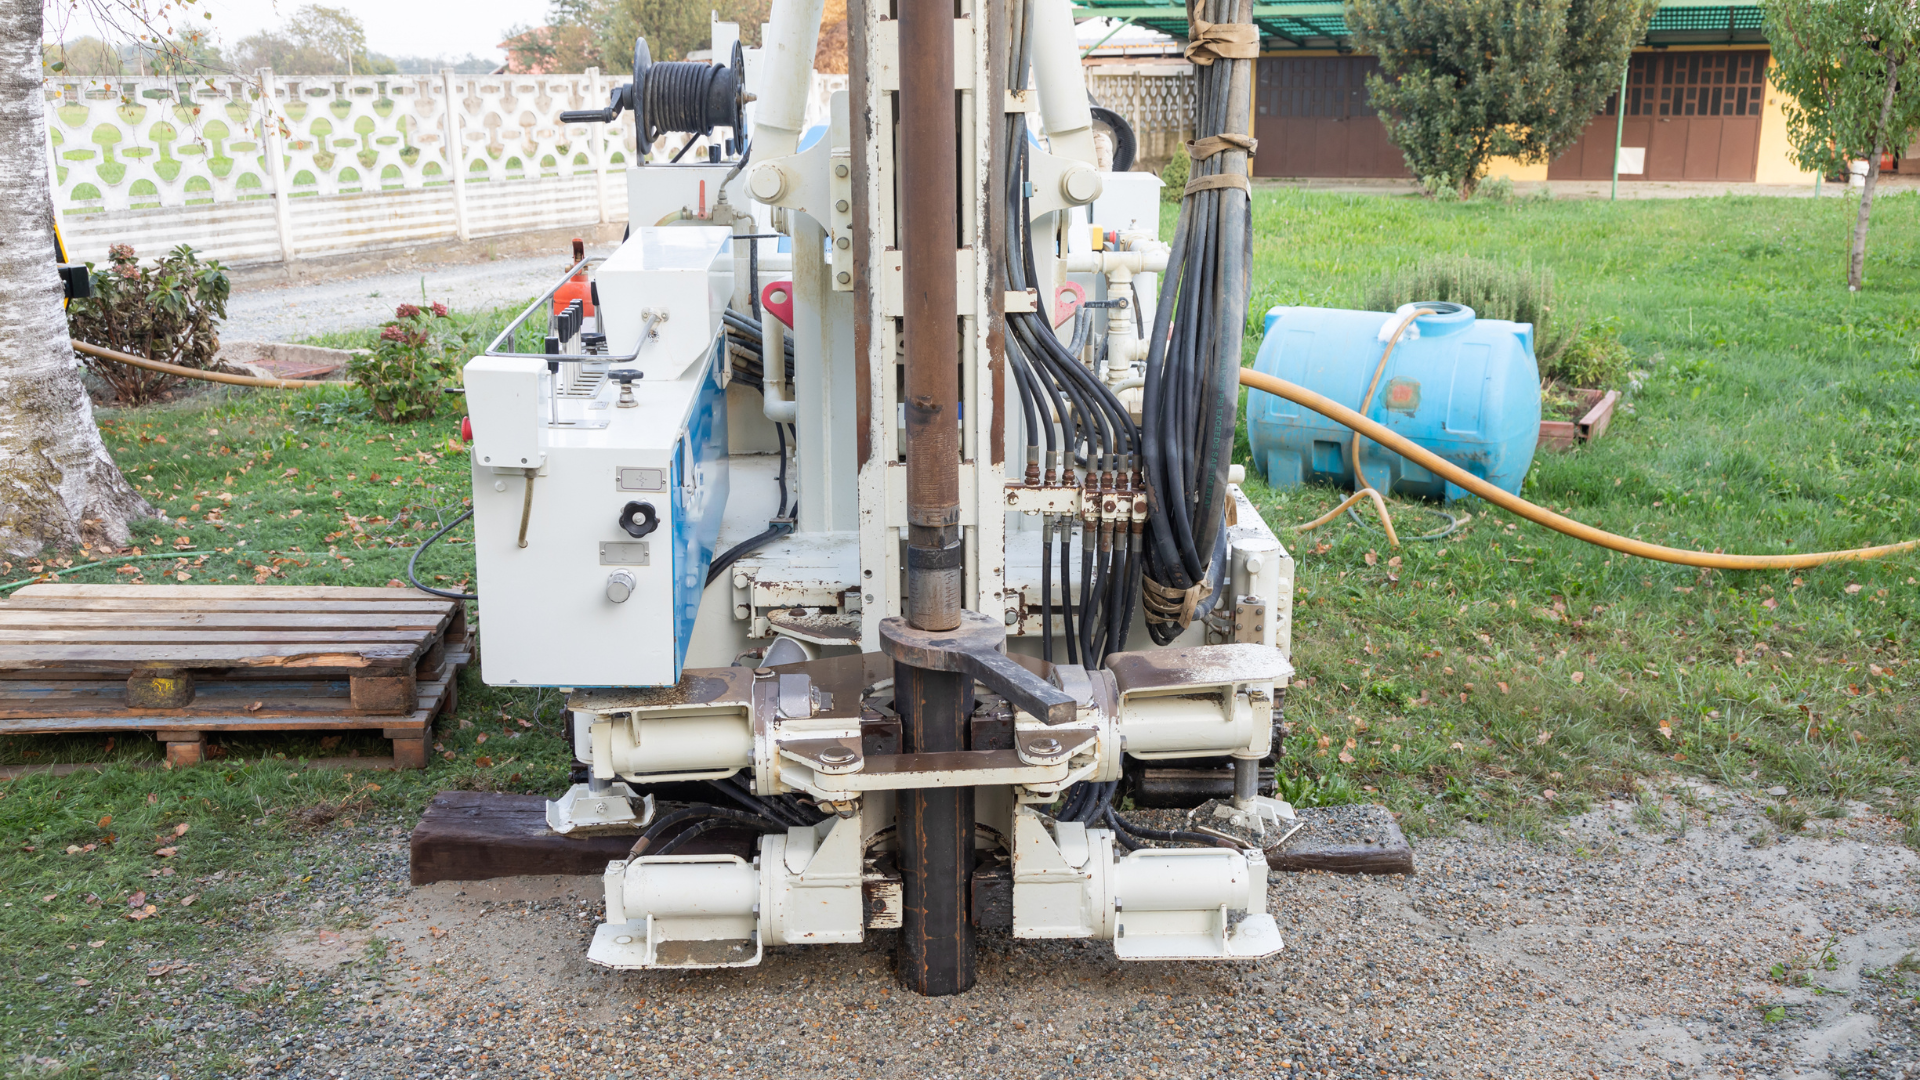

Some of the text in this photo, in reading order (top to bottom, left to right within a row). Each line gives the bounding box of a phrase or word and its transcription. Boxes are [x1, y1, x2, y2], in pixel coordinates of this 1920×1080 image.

[1216, 393, 1225, 407] PSI
[1212, 408, 1223, 450] EXCEEDS
[1209, 451, 1219, 469] SAE
[1206, 472, 1215, 486] 100
